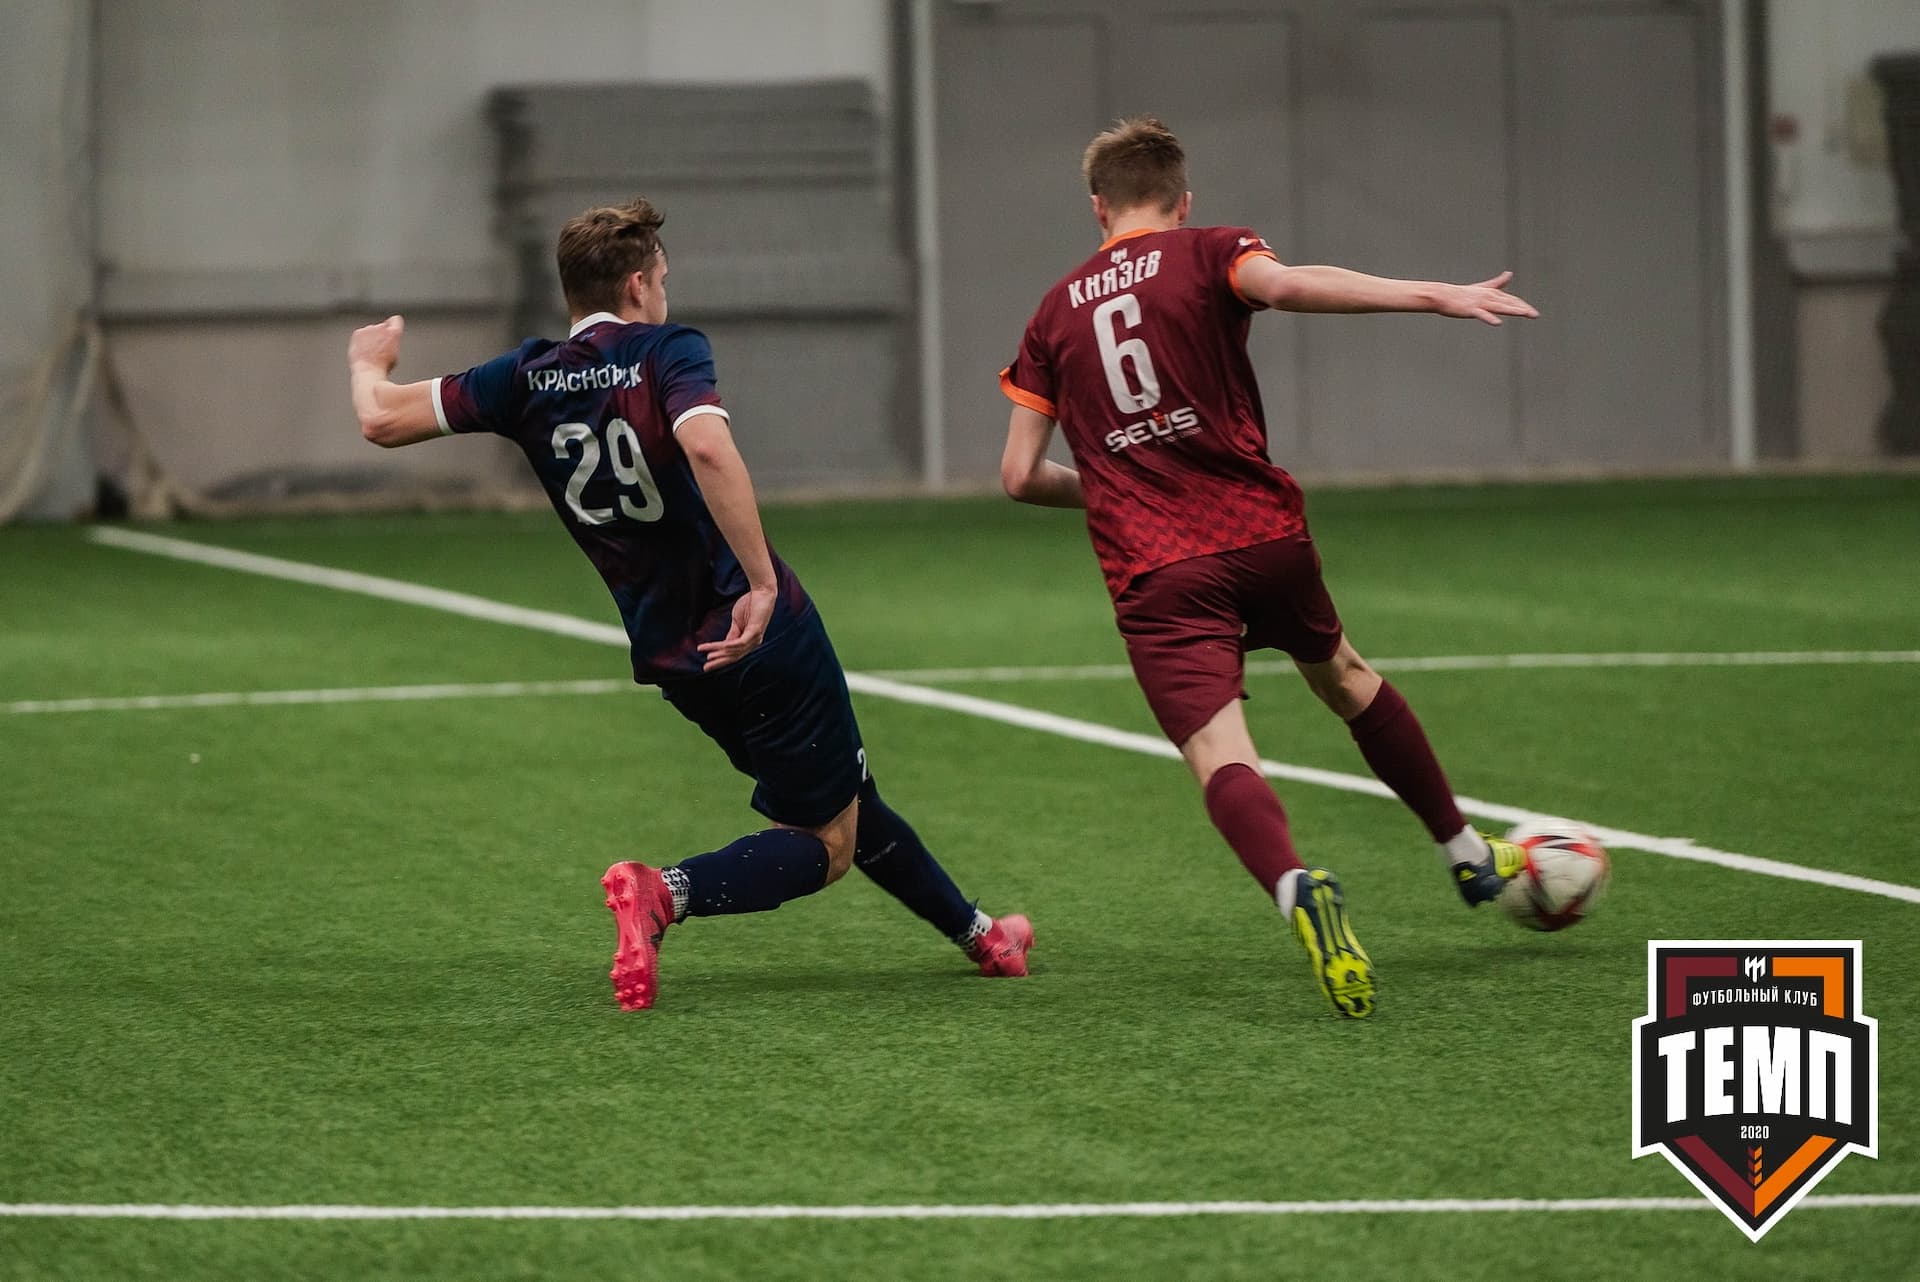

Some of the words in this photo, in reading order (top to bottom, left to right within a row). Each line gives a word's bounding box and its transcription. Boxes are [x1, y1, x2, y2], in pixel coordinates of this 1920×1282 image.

[1067, 250, 1162, 309] КНЯЗЕВ
[1092, 293, 1161, 415] 6
[551, 417, 665, 525] 29
